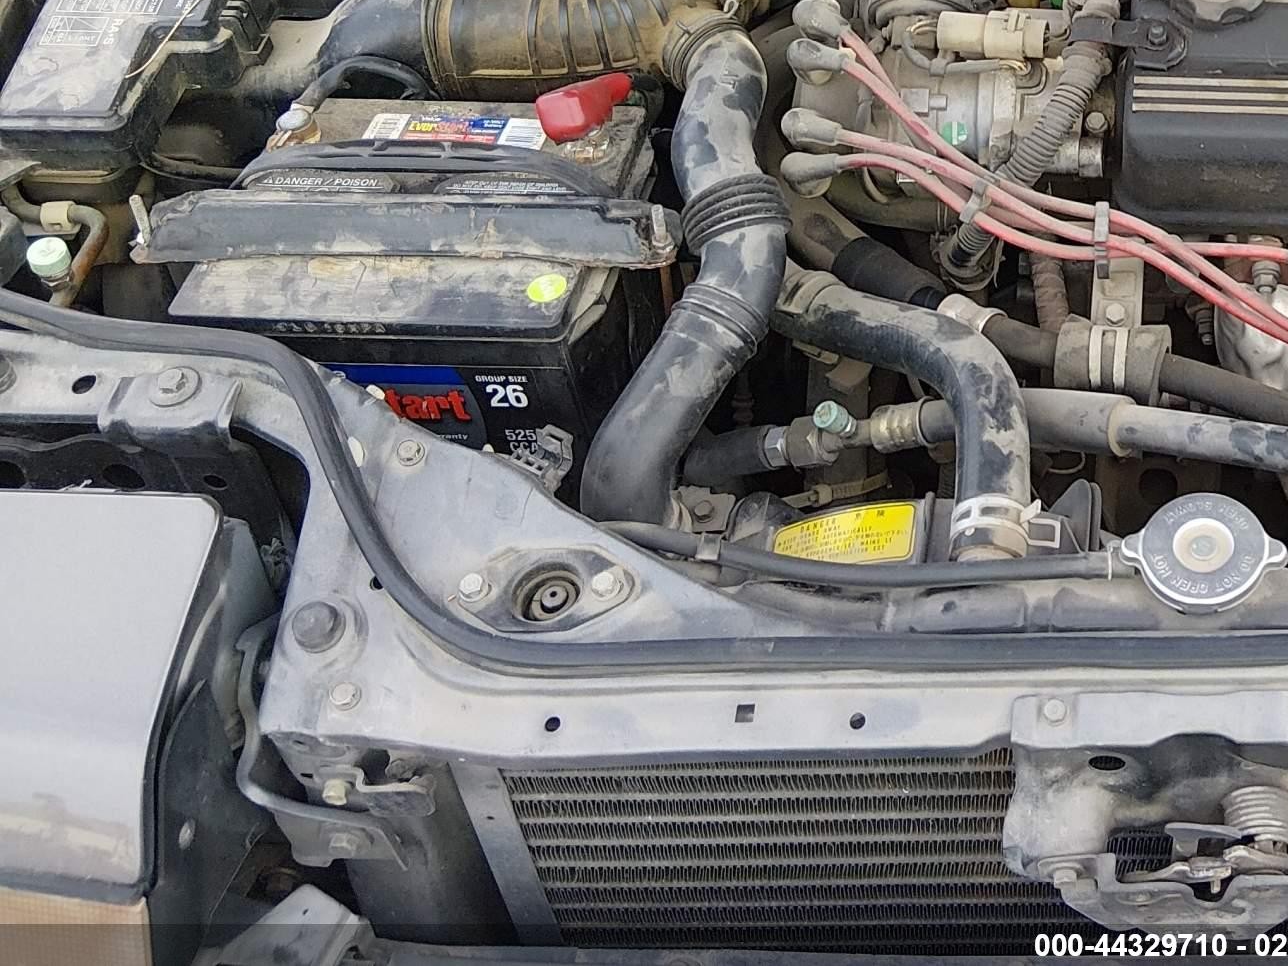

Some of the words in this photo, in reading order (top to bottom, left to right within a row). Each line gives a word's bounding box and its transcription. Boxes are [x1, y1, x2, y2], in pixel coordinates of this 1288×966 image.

[275, 177, 323, 186] DANGER
[333, 178, 378, 187] POISON
[475, 375, 506, 383] GROUP
[507, 375, 528, 383] SIZE
[485, 383, 529, 408] 26
[505, 429, 537, 441] 525
[1170, 574, 1209, 594] OPEN
